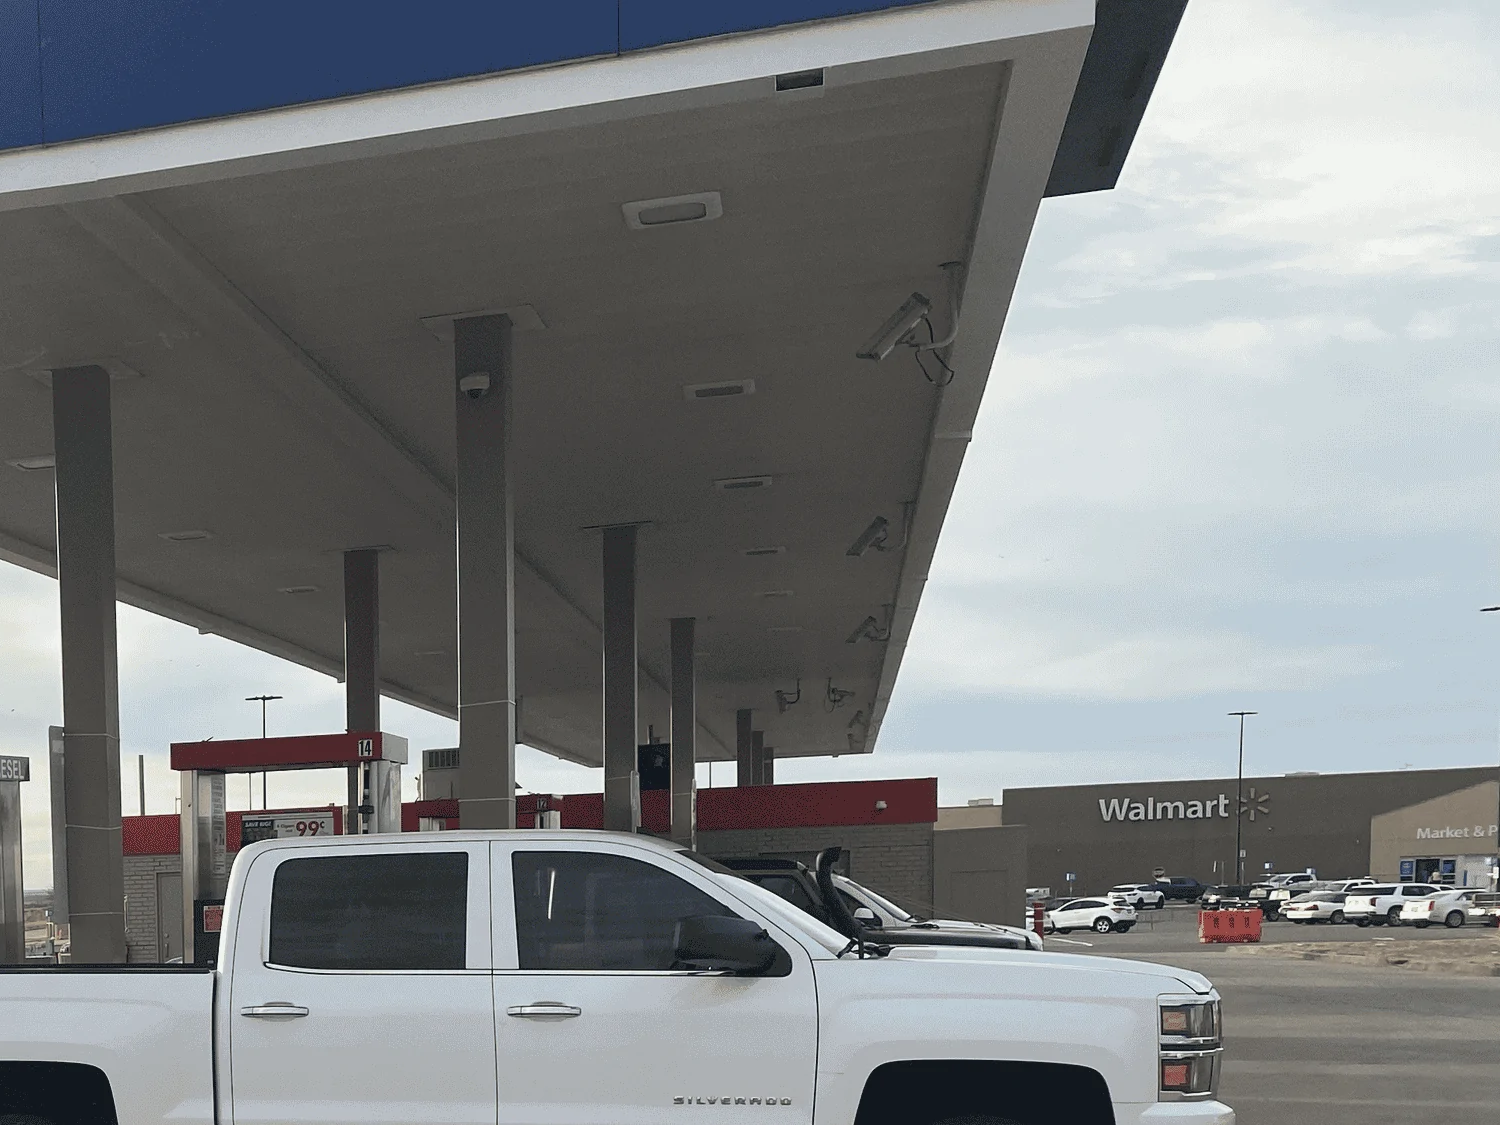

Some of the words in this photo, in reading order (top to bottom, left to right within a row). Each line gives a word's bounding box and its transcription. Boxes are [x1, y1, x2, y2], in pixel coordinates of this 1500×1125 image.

[359, 740, 372, 756] 14
[1098, 794, 1230, 822] Walmart
[1416, 826, 1470, 840] Market
[1473, 825, 1486, 838] &
[672, 1095, 793, 1106] SILVERADO
